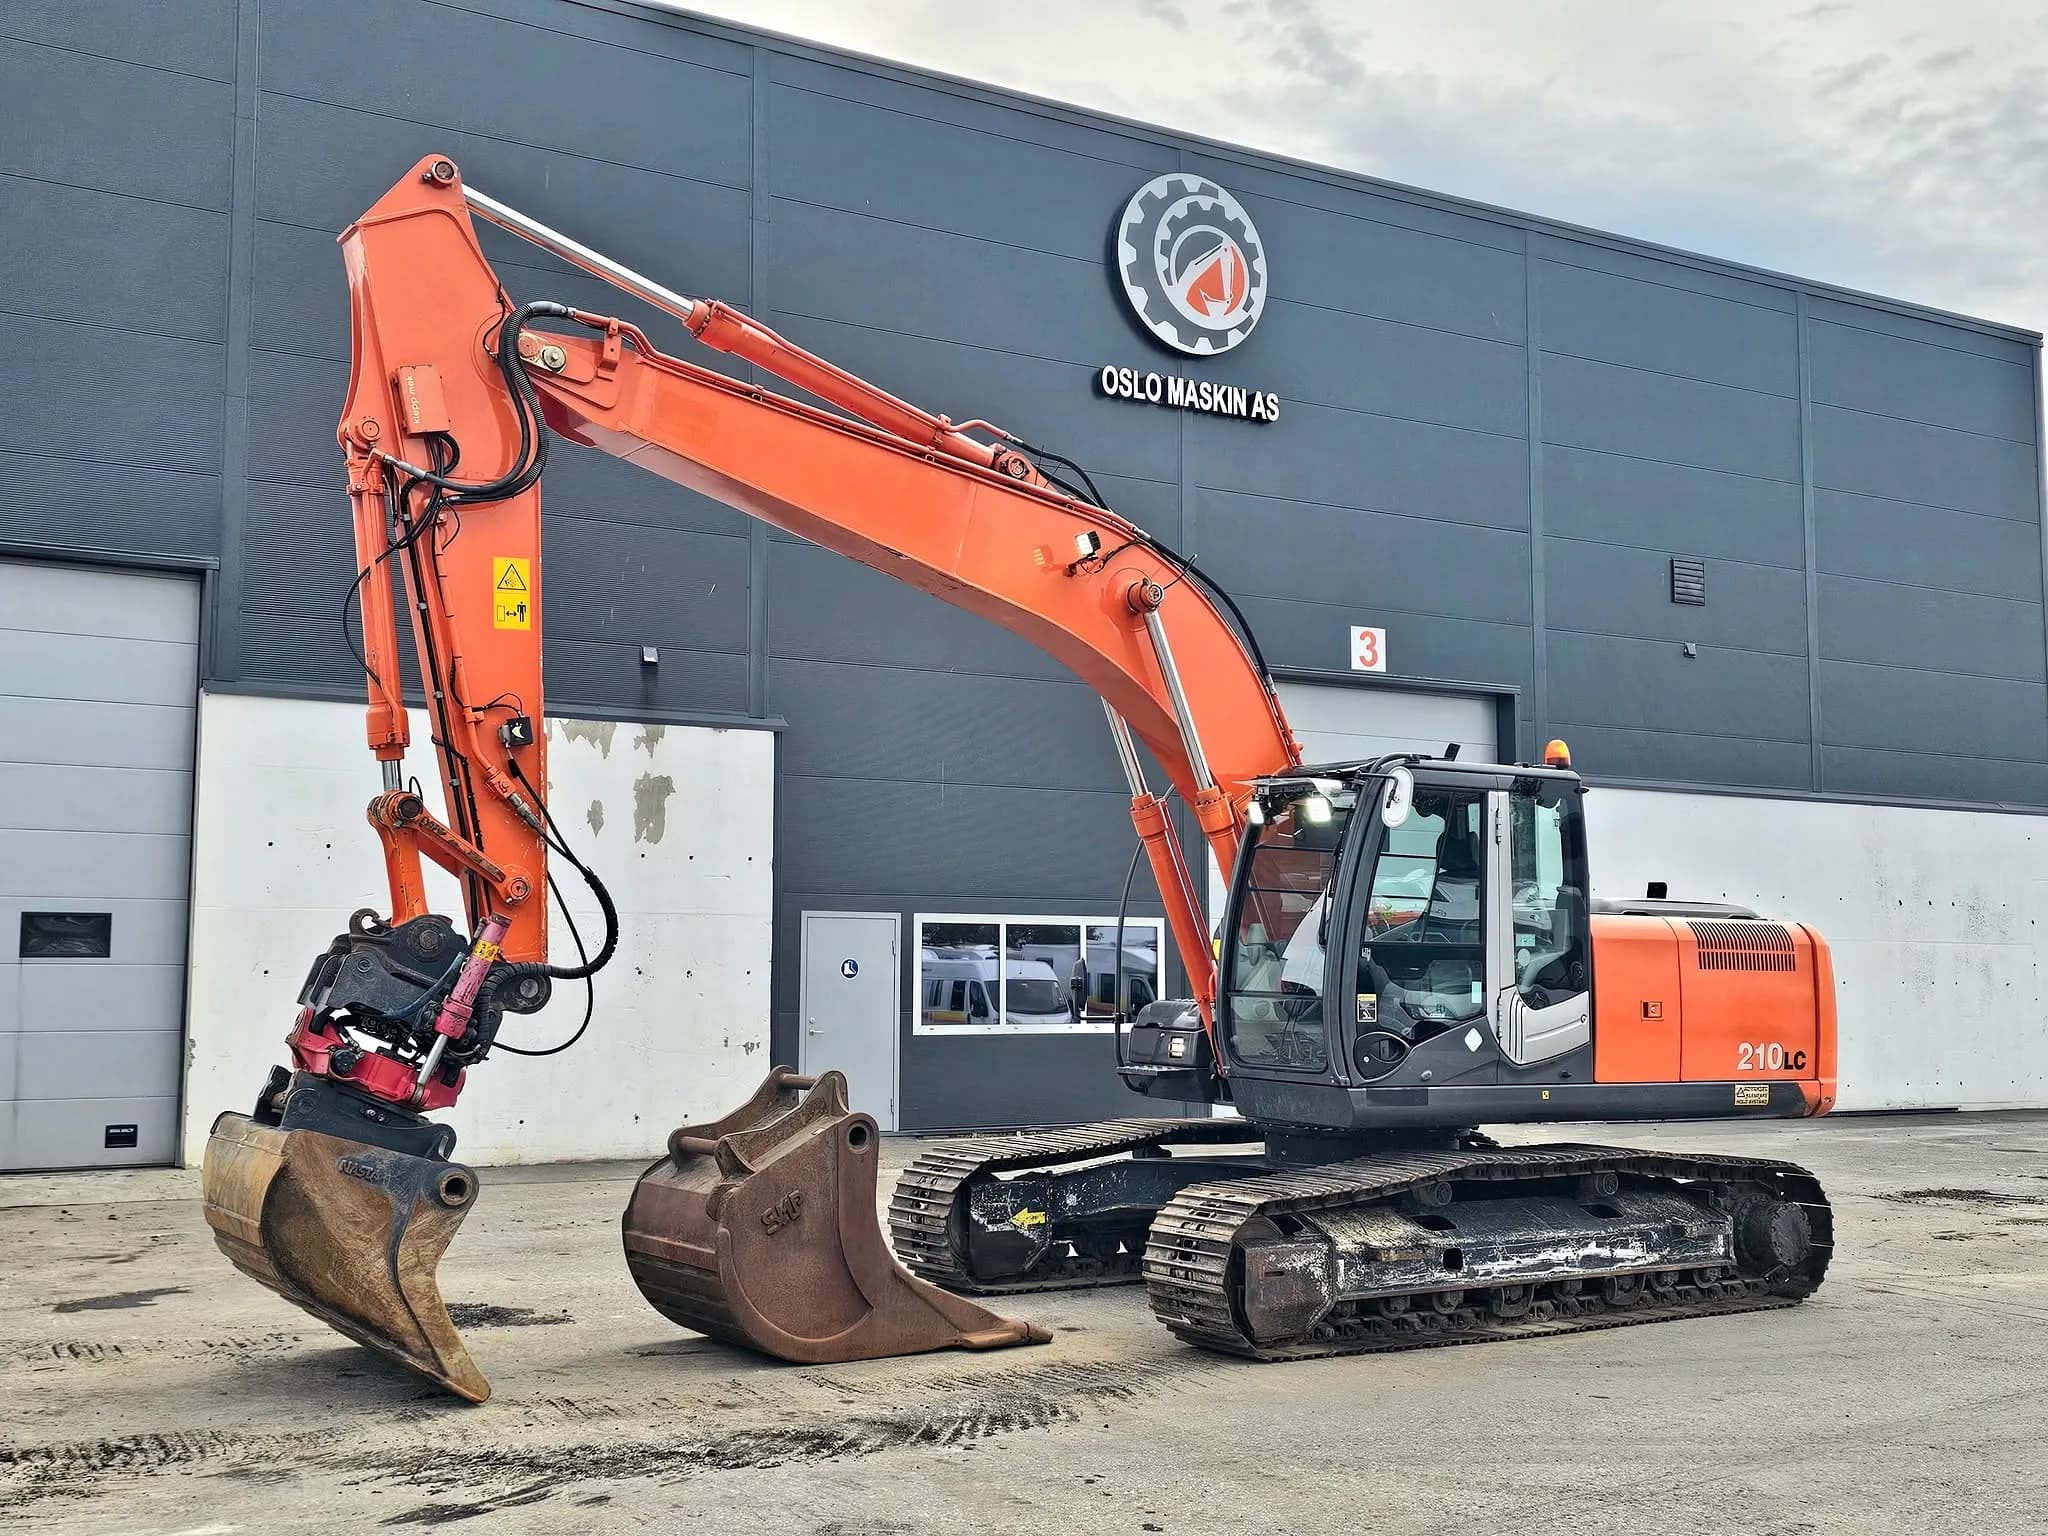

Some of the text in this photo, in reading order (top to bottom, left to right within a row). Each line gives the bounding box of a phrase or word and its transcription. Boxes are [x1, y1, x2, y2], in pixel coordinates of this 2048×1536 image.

[1102, 365, 1280, 422] OSLO MASKIN AS
[1359, 630, 1378, 667] 3
